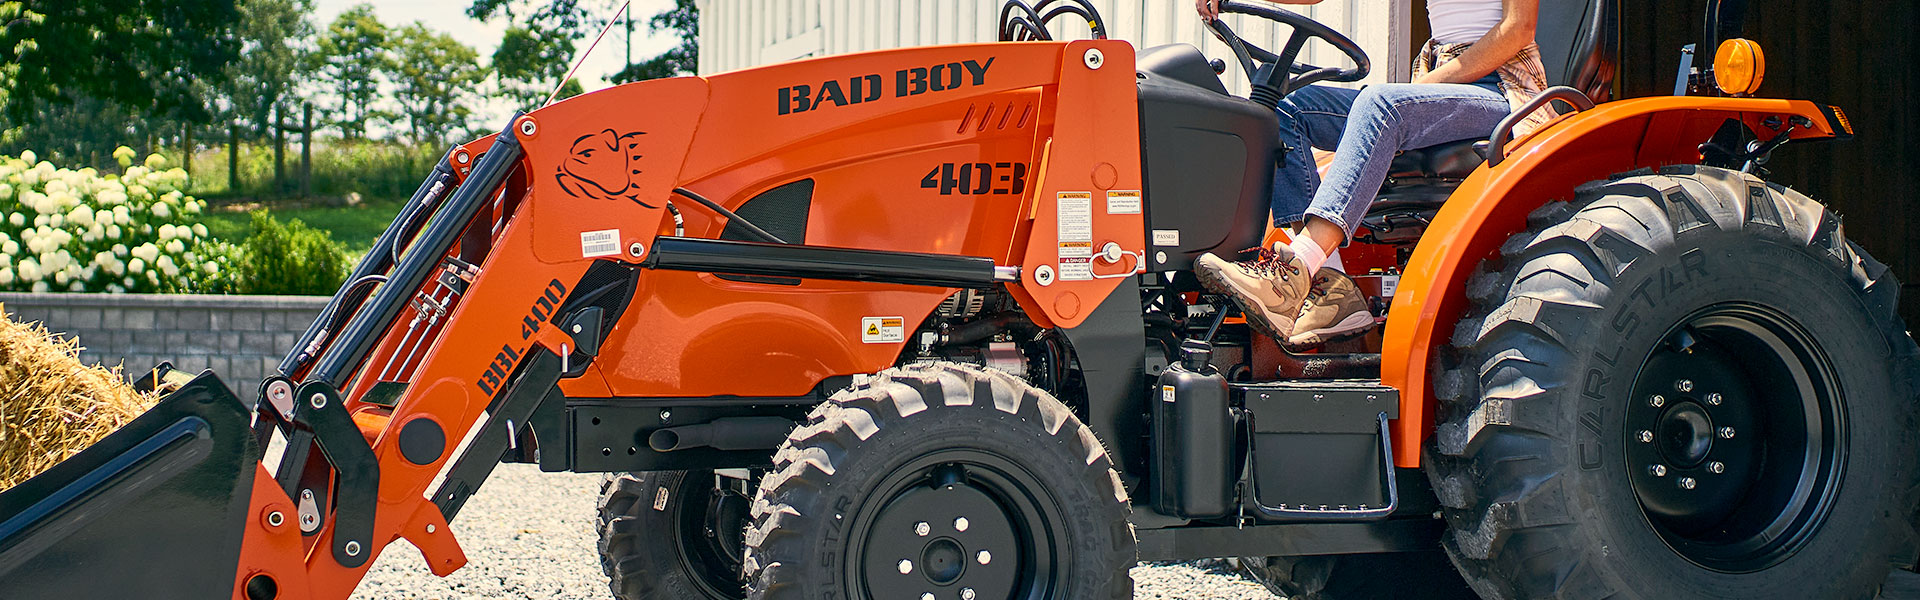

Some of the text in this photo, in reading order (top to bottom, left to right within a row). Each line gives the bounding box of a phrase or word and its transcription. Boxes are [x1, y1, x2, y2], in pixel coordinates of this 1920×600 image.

[778, 57, 996, 116] BAD BOY
[920, 162, 1032, 196] 403
[477, 278, 567, 397] BBL 400
[1577, 247, 1709, 472] CARLSTAR
